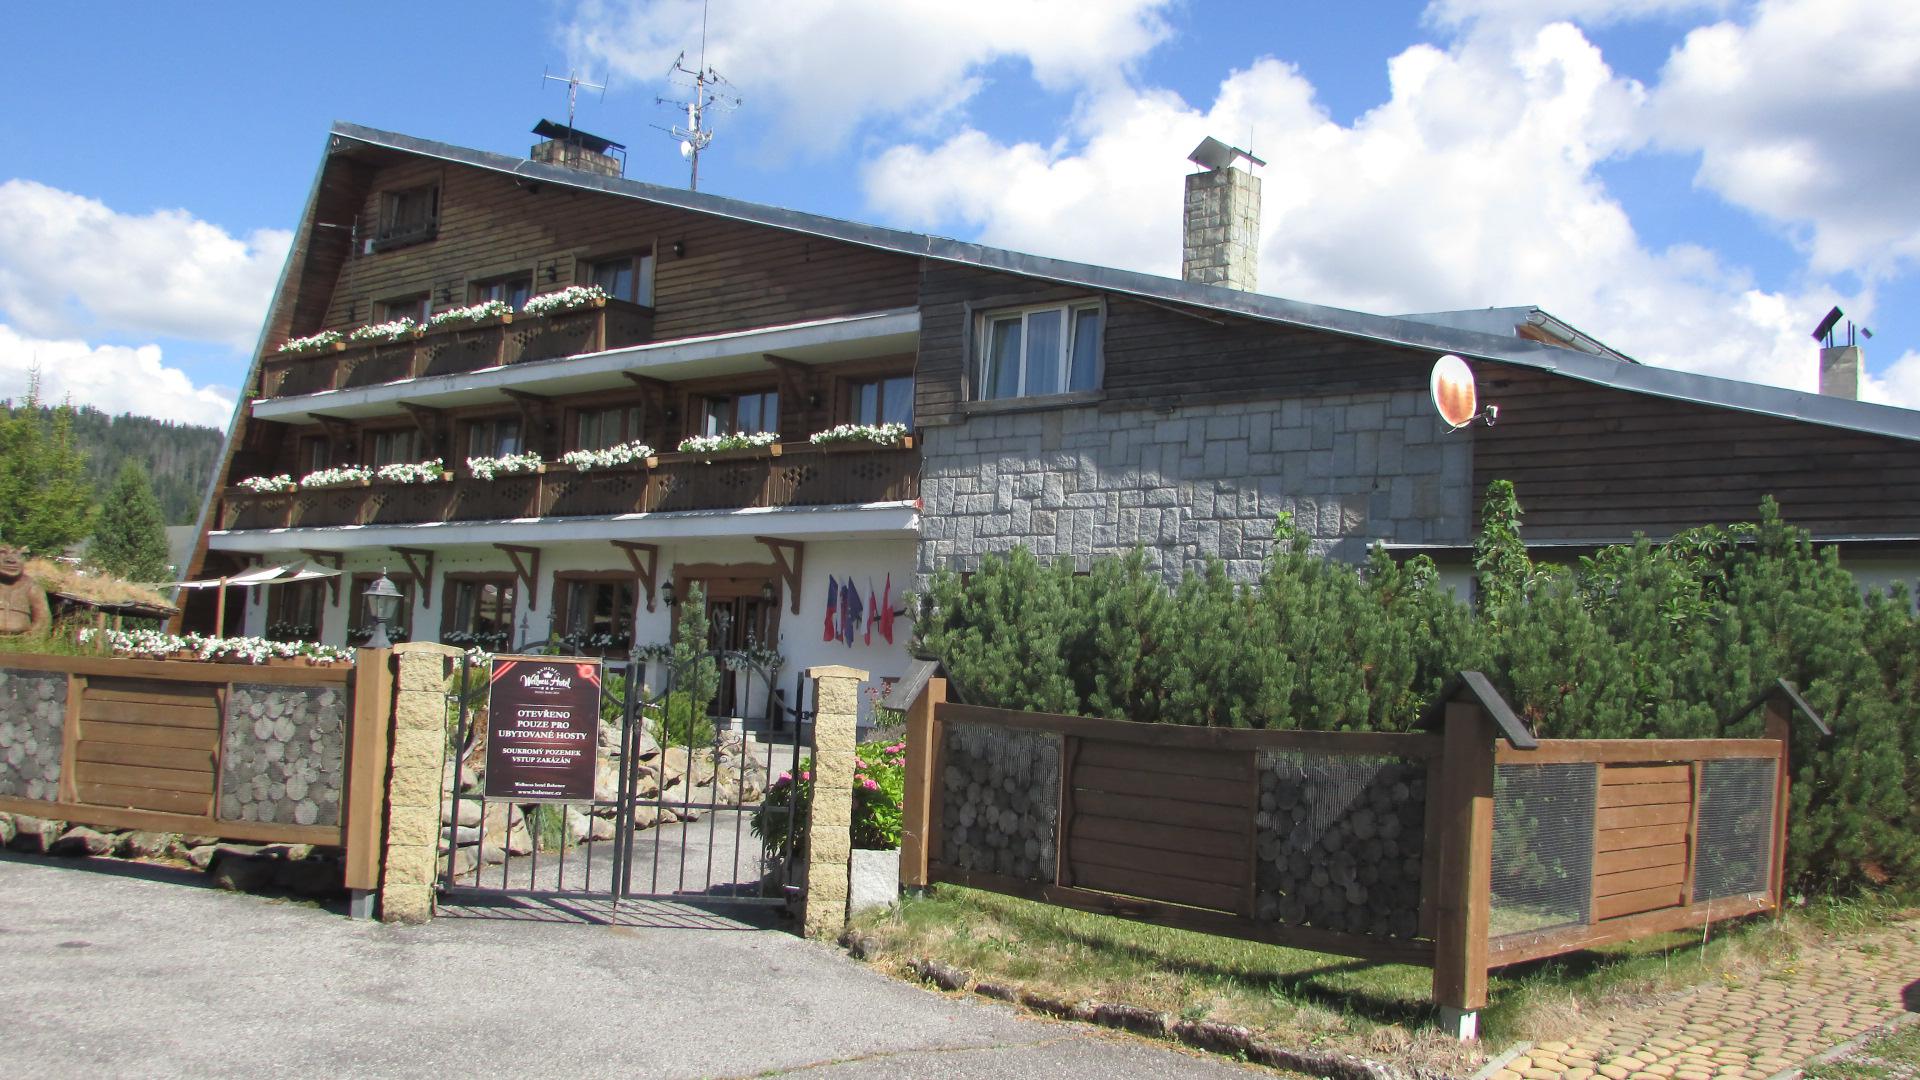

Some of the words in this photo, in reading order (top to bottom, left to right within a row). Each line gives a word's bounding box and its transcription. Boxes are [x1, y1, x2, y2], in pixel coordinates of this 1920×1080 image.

[550, 677, 571, 689] Hotel
[517, 709, 570, 719] OTEVŘENO
[517, 720, 549, 728] POUZE
[551, 721, 570, 729] PRO
[498, 729, 554, 739] UBYTOVANÉ
[556, 731, 587, 740] HOSTY
[502, 746, 544, 755] SOUKROMÝ
[536, 756, 571, 764] ZAKÁZÁN
